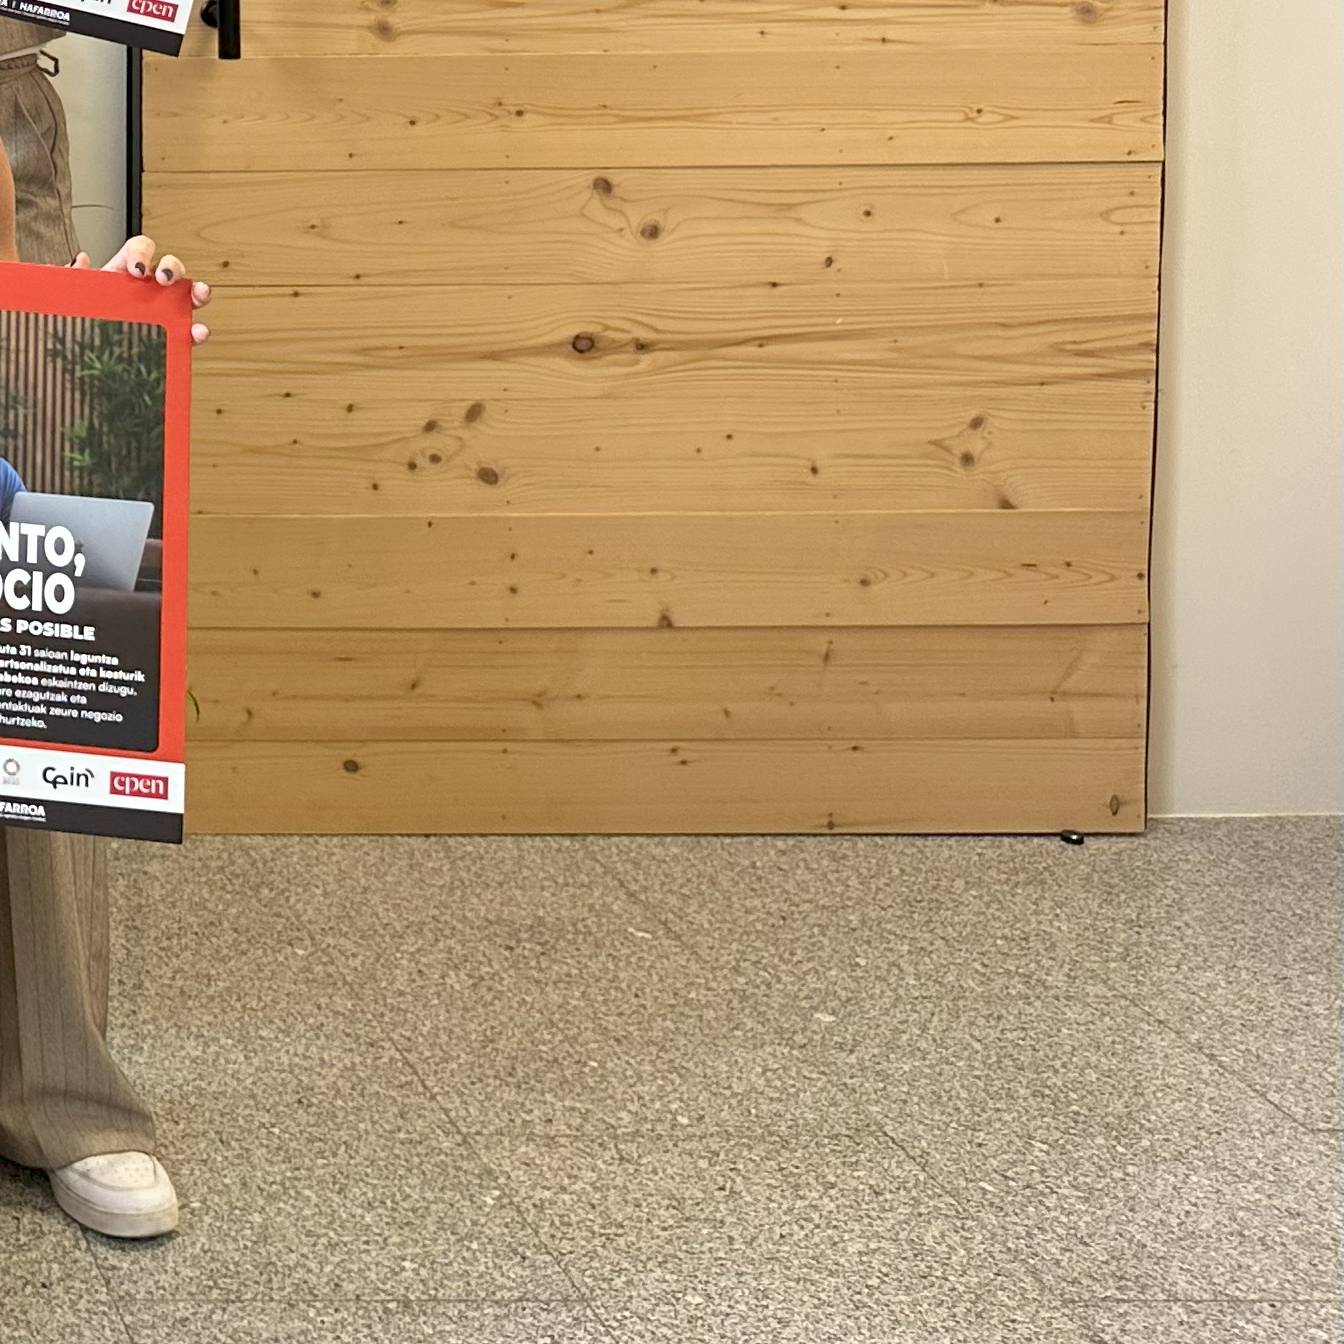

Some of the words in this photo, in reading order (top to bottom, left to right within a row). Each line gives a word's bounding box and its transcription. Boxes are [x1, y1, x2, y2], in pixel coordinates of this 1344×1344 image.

[19, 1, 70, 22] NAFARROA
[16, 619, 95, 641] POSIBLE
[19, 644, 31, 656] 31
[33, 648, 67, 660] saioan
[70, 649, 118, 666] laguntza
[78, 666, 96, 677] eta
[99, 666, 144, 682] kosturik
[40, 676, 95, 691] eskaintzen
[14, 689, 68, 703] ezagutzak
[69, 694, 87, 704] eta
[49, 706, 78, 718] zeure
[80, 710, 123, 723] negozio
